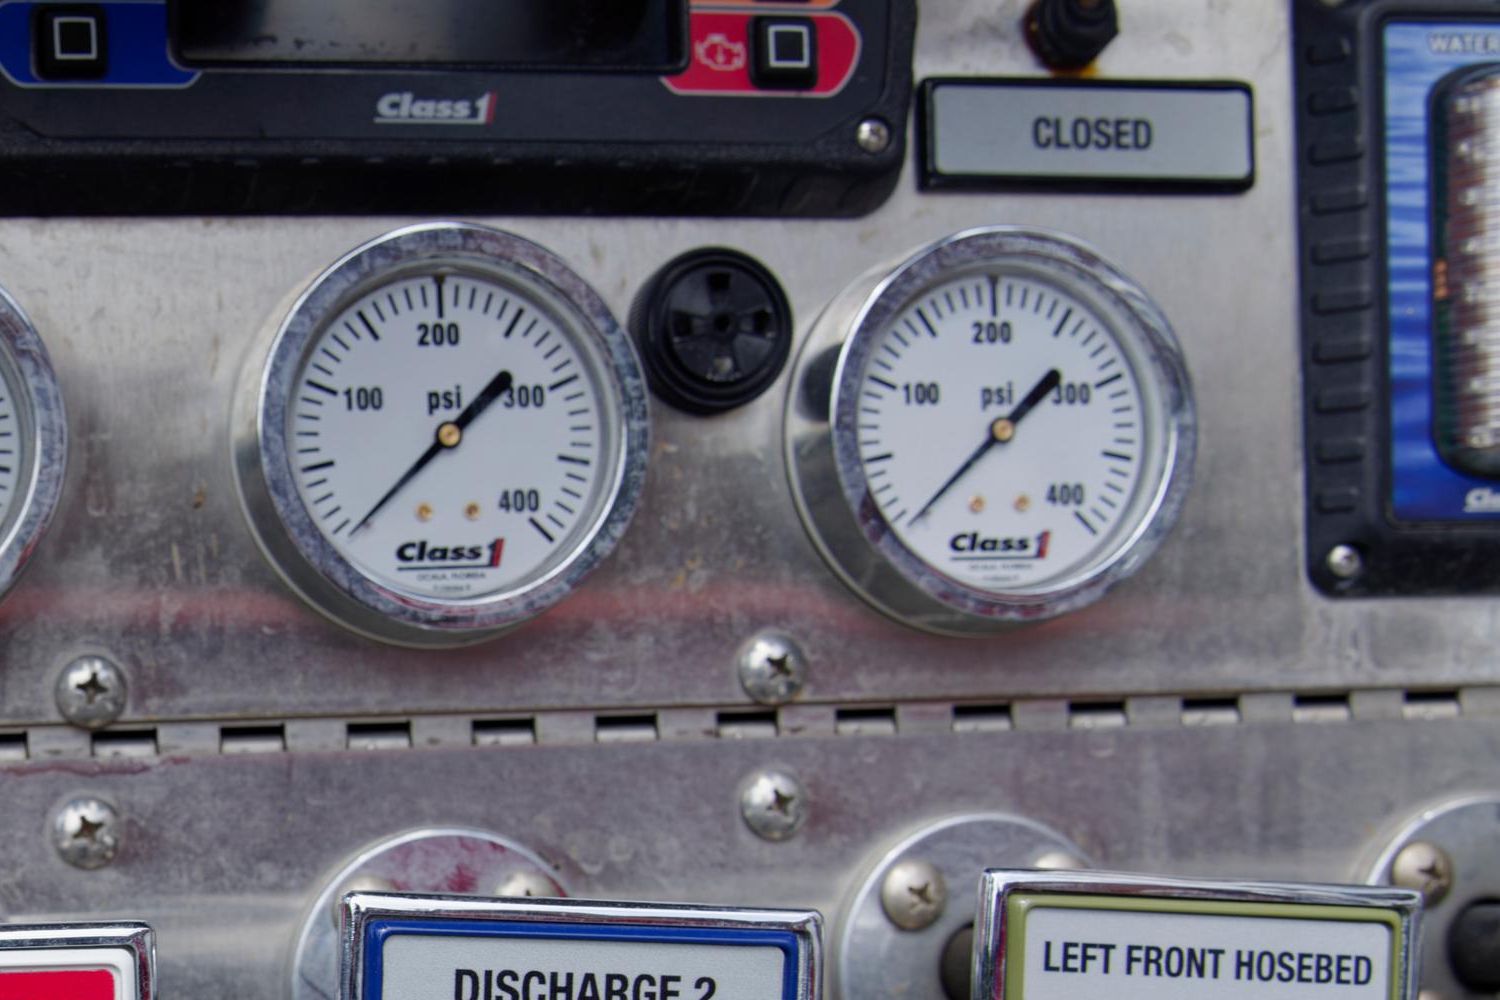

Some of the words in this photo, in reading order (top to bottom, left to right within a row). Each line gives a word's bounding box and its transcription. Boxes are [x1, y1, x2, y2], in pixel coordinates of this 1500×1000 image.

[376, 92, 495, 124] Class1
[1033, 116, 1152, 150] CLOSED
[417, 323, 460, 347] 200
[972, 321, 1012, 344] 200
[343, 387, 383, 411] 100
[428, 384, 462, 414] psi
[504, 384, 545, 408] 300
[902, 383, 939, 405] 100
[981, 381, 1014, 410] psi
[499, 489, 540, 512] 400
[1046, 483, 1084, 506] 400
[396, 538, 505, 567] Class1
[949, 531, 1051, 558] Class1
[1044, 941, 1116, 974] LEFT
[1125, 945, 1225, 979] FRONT
[1235, 950, 1373, 985] HOSEBED
